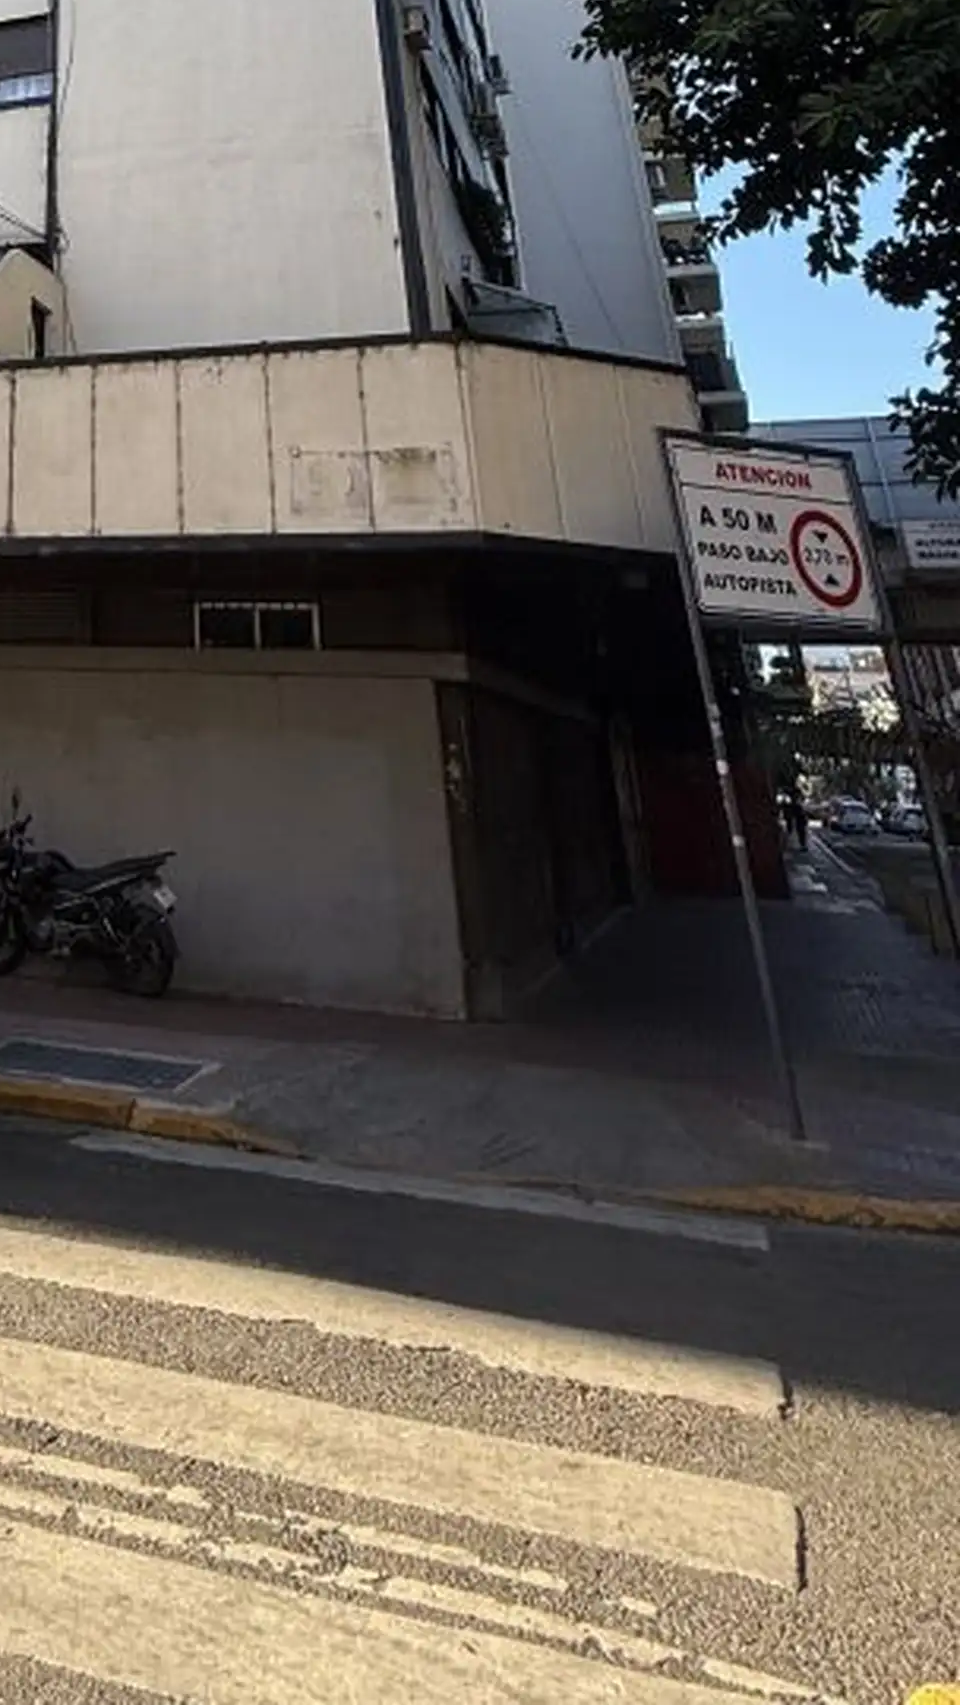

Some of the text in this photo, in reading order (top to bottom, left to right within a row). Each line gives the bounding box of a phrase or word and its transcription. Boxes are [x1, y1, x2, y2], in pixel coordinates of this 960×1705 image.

[715, 461, 813, 490] ATENCION
[700, 504, 778, 536] A 50 M
[696, 541, 789, 566] PASO BAJO
[703, 572, 798, 597] AUTOPISTA
